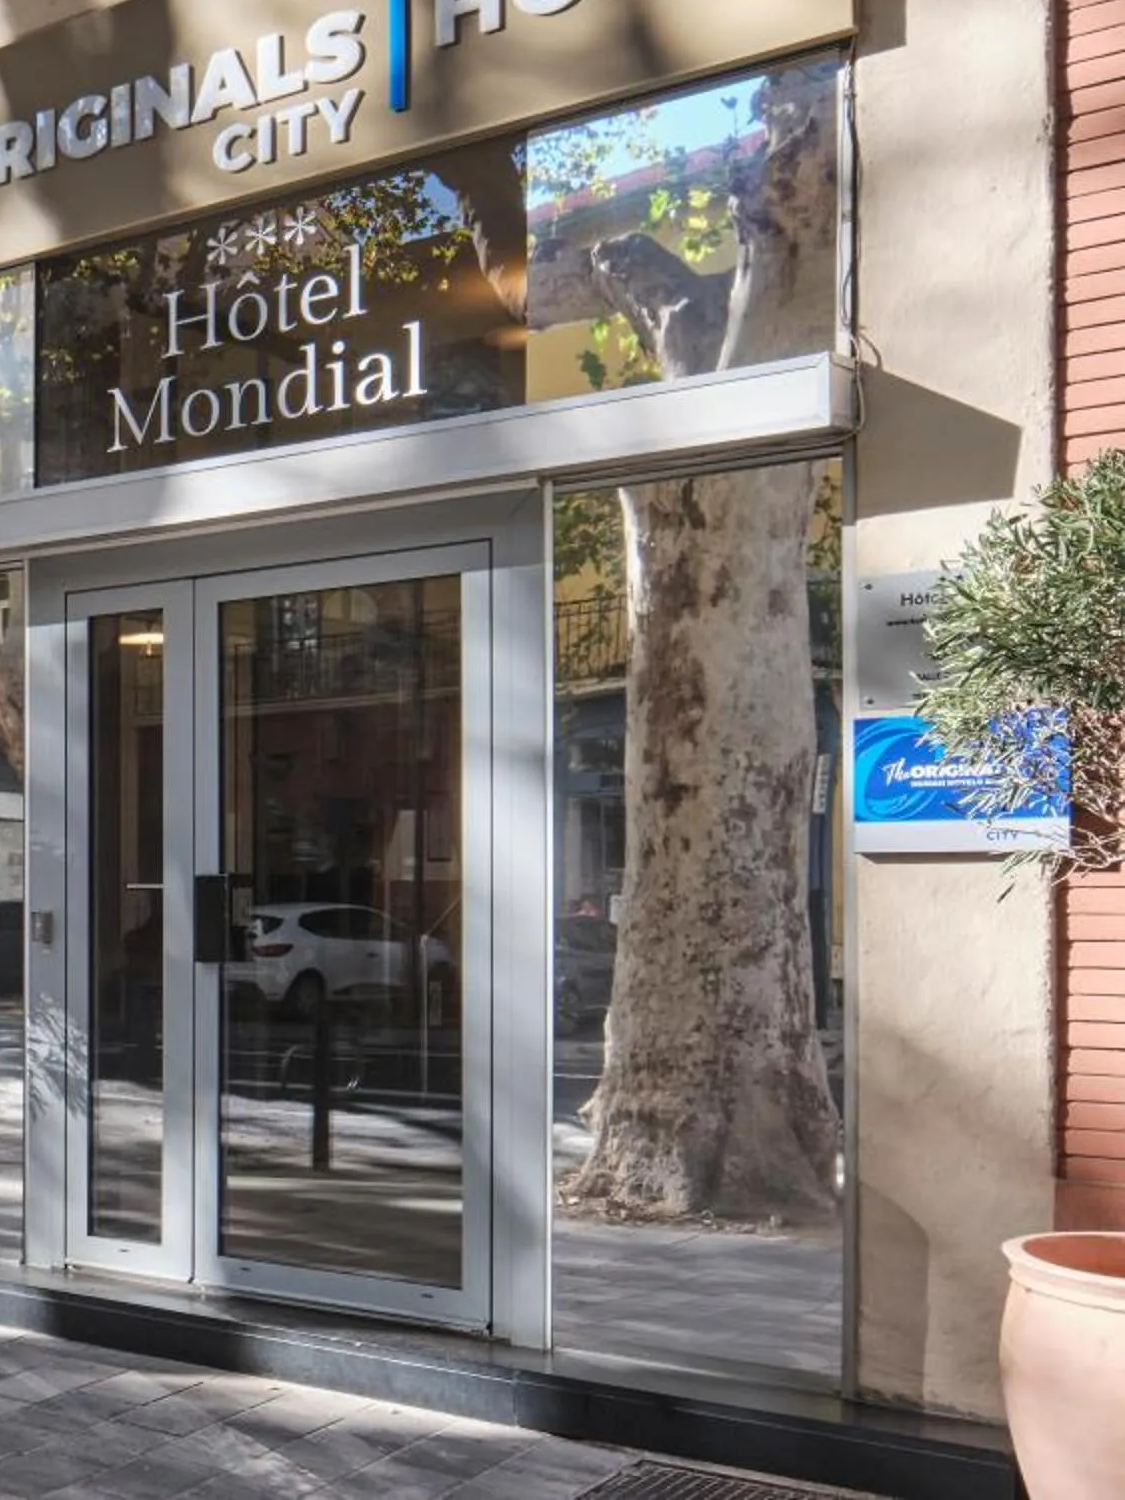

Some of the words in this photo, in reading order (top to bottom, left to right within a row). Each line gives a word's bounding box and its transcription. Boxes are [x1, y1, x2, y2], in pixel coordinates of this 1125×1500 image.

[212, 88, 364, 175] CITY
[161, 244, 369, 359] Hôtel
[107, 321, 428, 453] Mondial
[986, 829, 1020, 841] CITY
